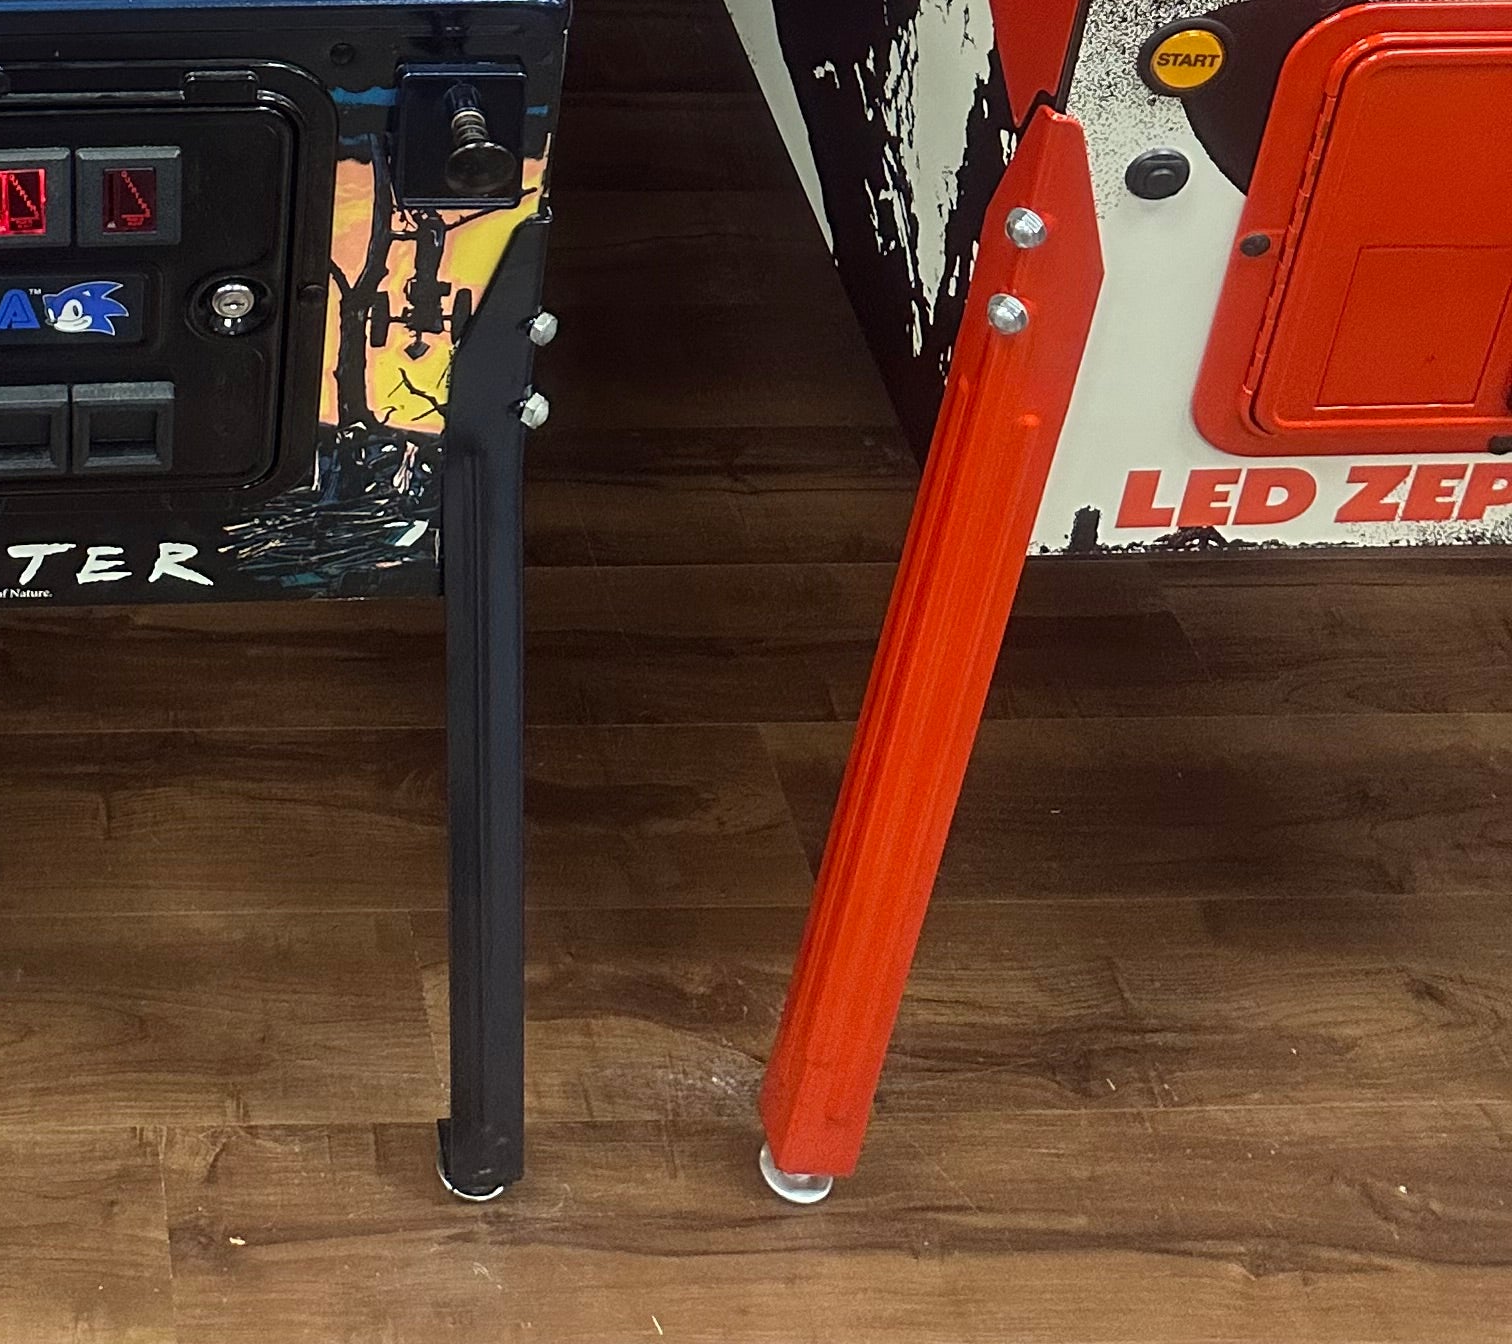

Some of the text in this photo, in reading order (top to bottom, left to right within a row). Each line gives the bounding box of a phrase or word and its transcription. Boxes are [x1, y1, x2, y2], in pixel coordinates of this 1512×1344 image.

[1156, 52, 1223, 70] START
[1115, 466, 1317, 529] LED
[10, 588, 53, 600] Nature.
